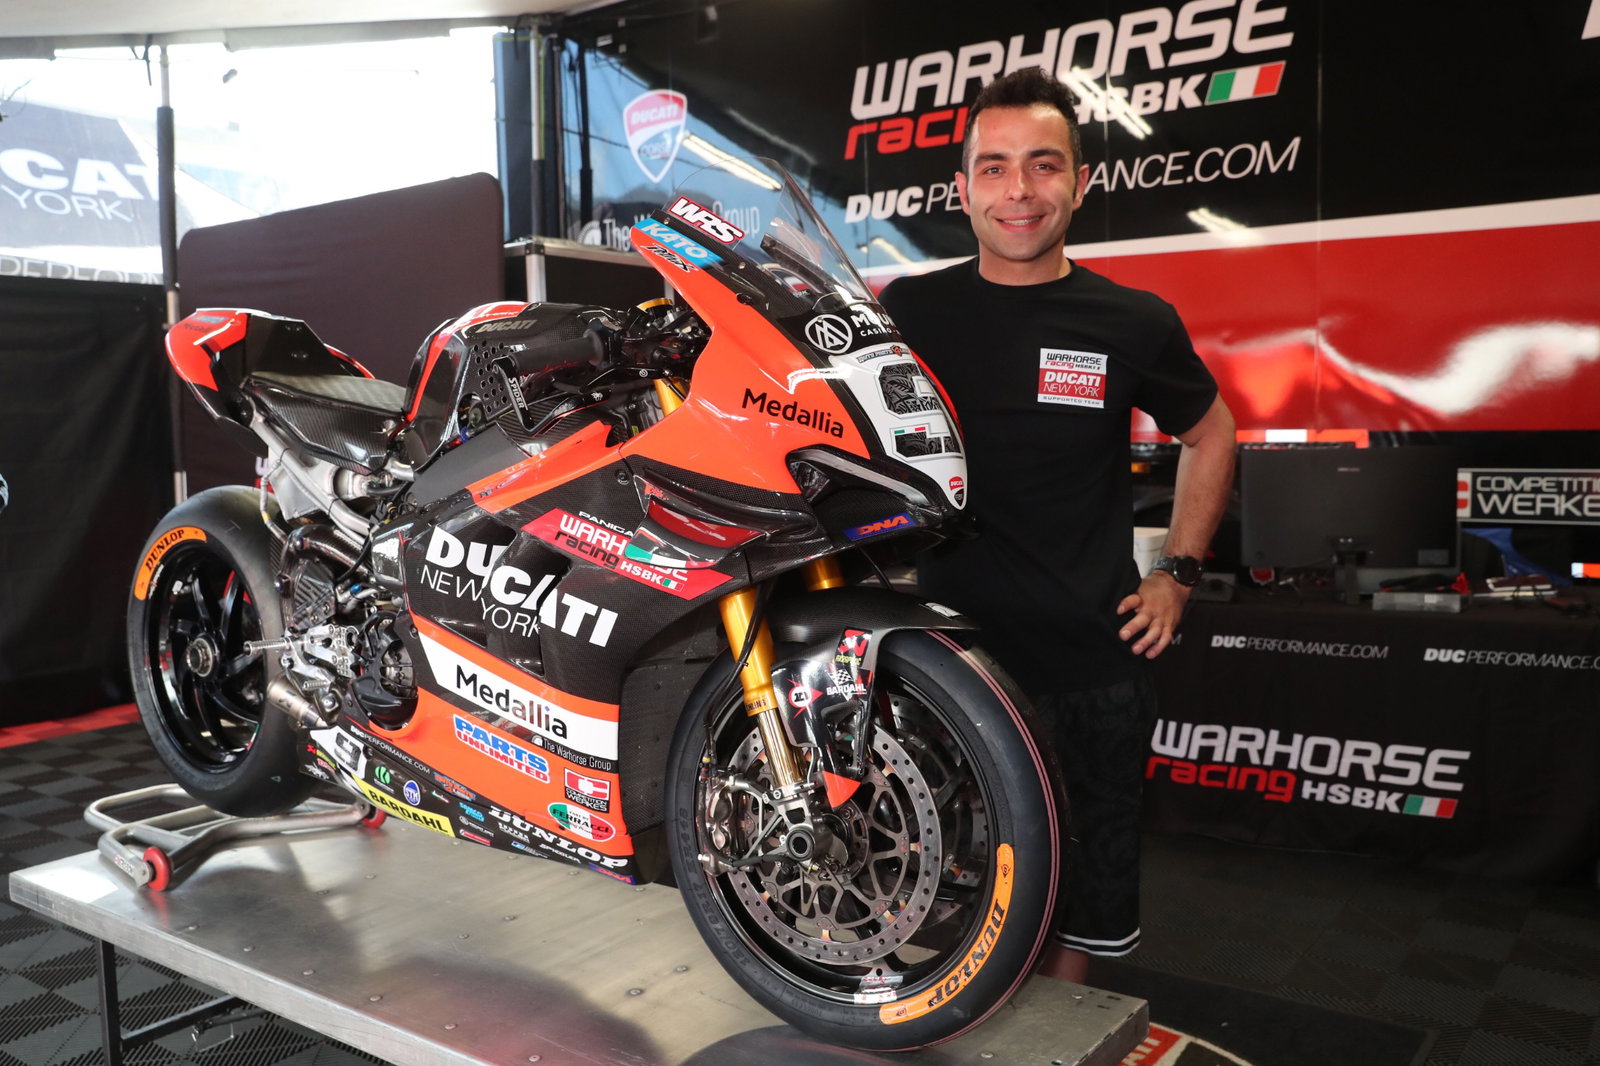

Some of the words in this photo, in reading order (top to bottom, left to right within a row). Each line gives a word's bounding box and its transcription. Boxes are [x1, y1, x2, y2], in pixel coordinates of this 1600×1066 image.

[850, 0, 1296, 121] WARHORSE
[631, 104, 678, 127] DUCATI
[844, 106, 972, 160] raci
[1, 184, 133, 222] YORK
[670, 198, 743, 243] WRS
[641, 223, 710, 259] KATO
[476, 319, 537, 333] DUCATI
[1044, 371, 1101, 387] DUCATI
[1045, 361, 1075, 369] racing
[1046, 353, 1102, 365] WARHORSE
[509, 377, 526, 409] SPIDER
[1043, 383, 1071, 394] NEW
[1074, 385, 1100, 397] YORK
[741, 388, 844, 439] Medallia
[858, 515, 910, 535] DNA
[145, 529, 185, 571] DUNLOP
[554, 531, 620, 570] racing
[620, 560, 664, 585] HSBK
[420, 565, 482, 601] NEW
[480, 597, 541, 638] YORK
[425, 526, 619, 648] DUCATI
[1211, 635, 1389, 660] DUCPERFORMANCE.COM
[456, 665, 568, 740] Medallia
[826, 683, 867, 696] BARDAHL
[350, 725, 431, 775] DUCPERFORMANCE.COM
[454, 716, 548, 773] PARTS
[457, 730, 548, 782] UNLIMITED
[543, 737, 555, 752] The
[557, 743, 588, 767] Warhorse
[589, 757, 612, 771] Group
[1150, 718, 1472, 792] WARHORSE
[1145, 756, 1297, 804] racing
[1302, 779, 1405, 813] HSBK
[369, 790, 449, 833] BARDAHL
[551, 807, 610, 833] FERRACCI
[488, 805, 629, 870] DUNLOP
[928, 899, 1006, 1008] DUNLOP
